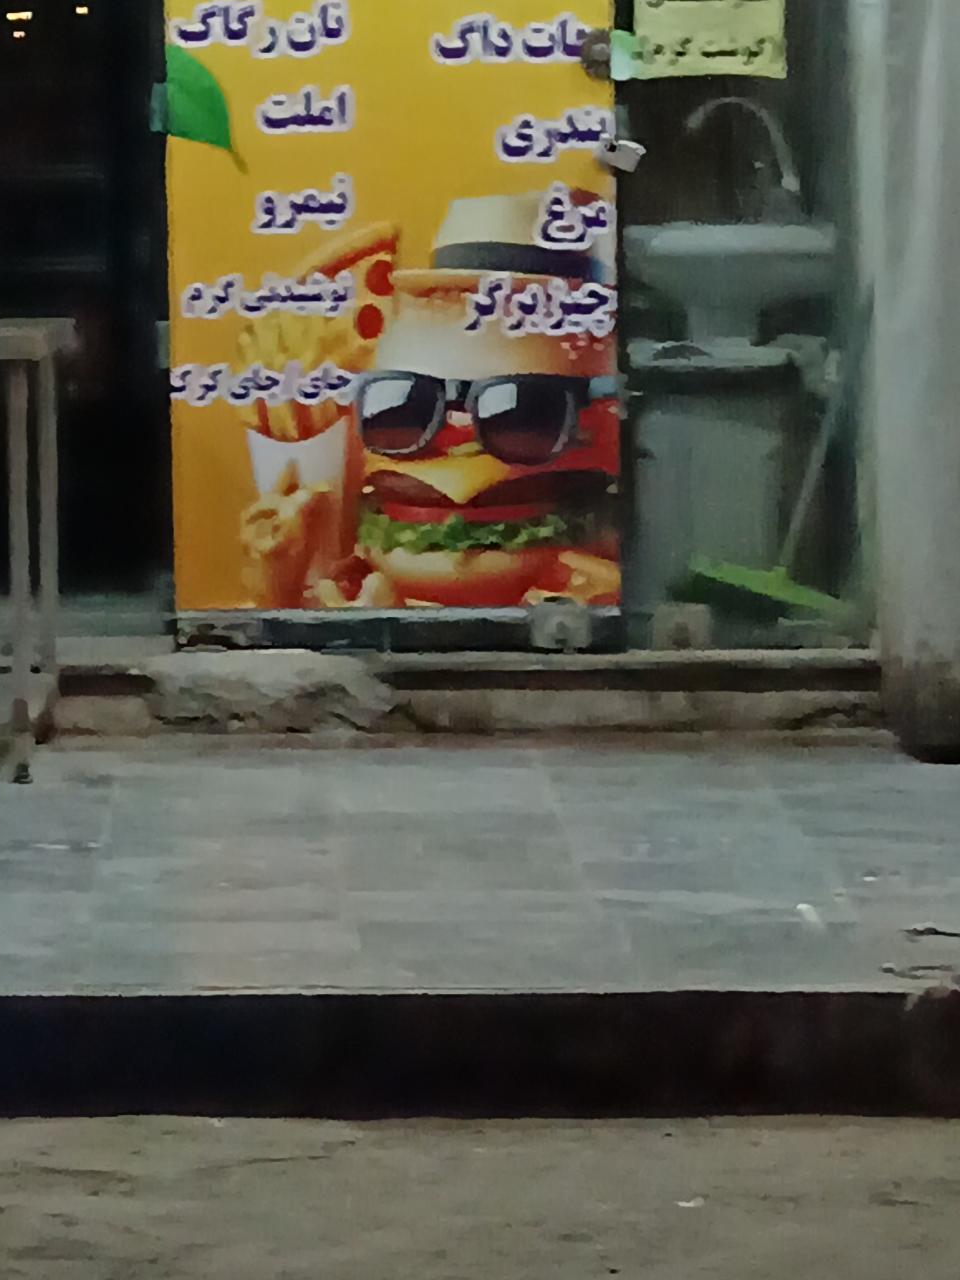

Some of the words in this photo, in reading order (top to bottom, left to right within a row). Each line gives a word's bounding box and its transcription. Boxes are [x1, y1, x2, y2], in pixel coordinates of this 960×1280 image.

[287, 3, 344, 52] نان
[435, 19, 514, 59] داگ
[262, 90, 348, 128] املت
[256, 177, 348, 229] نیمرو
